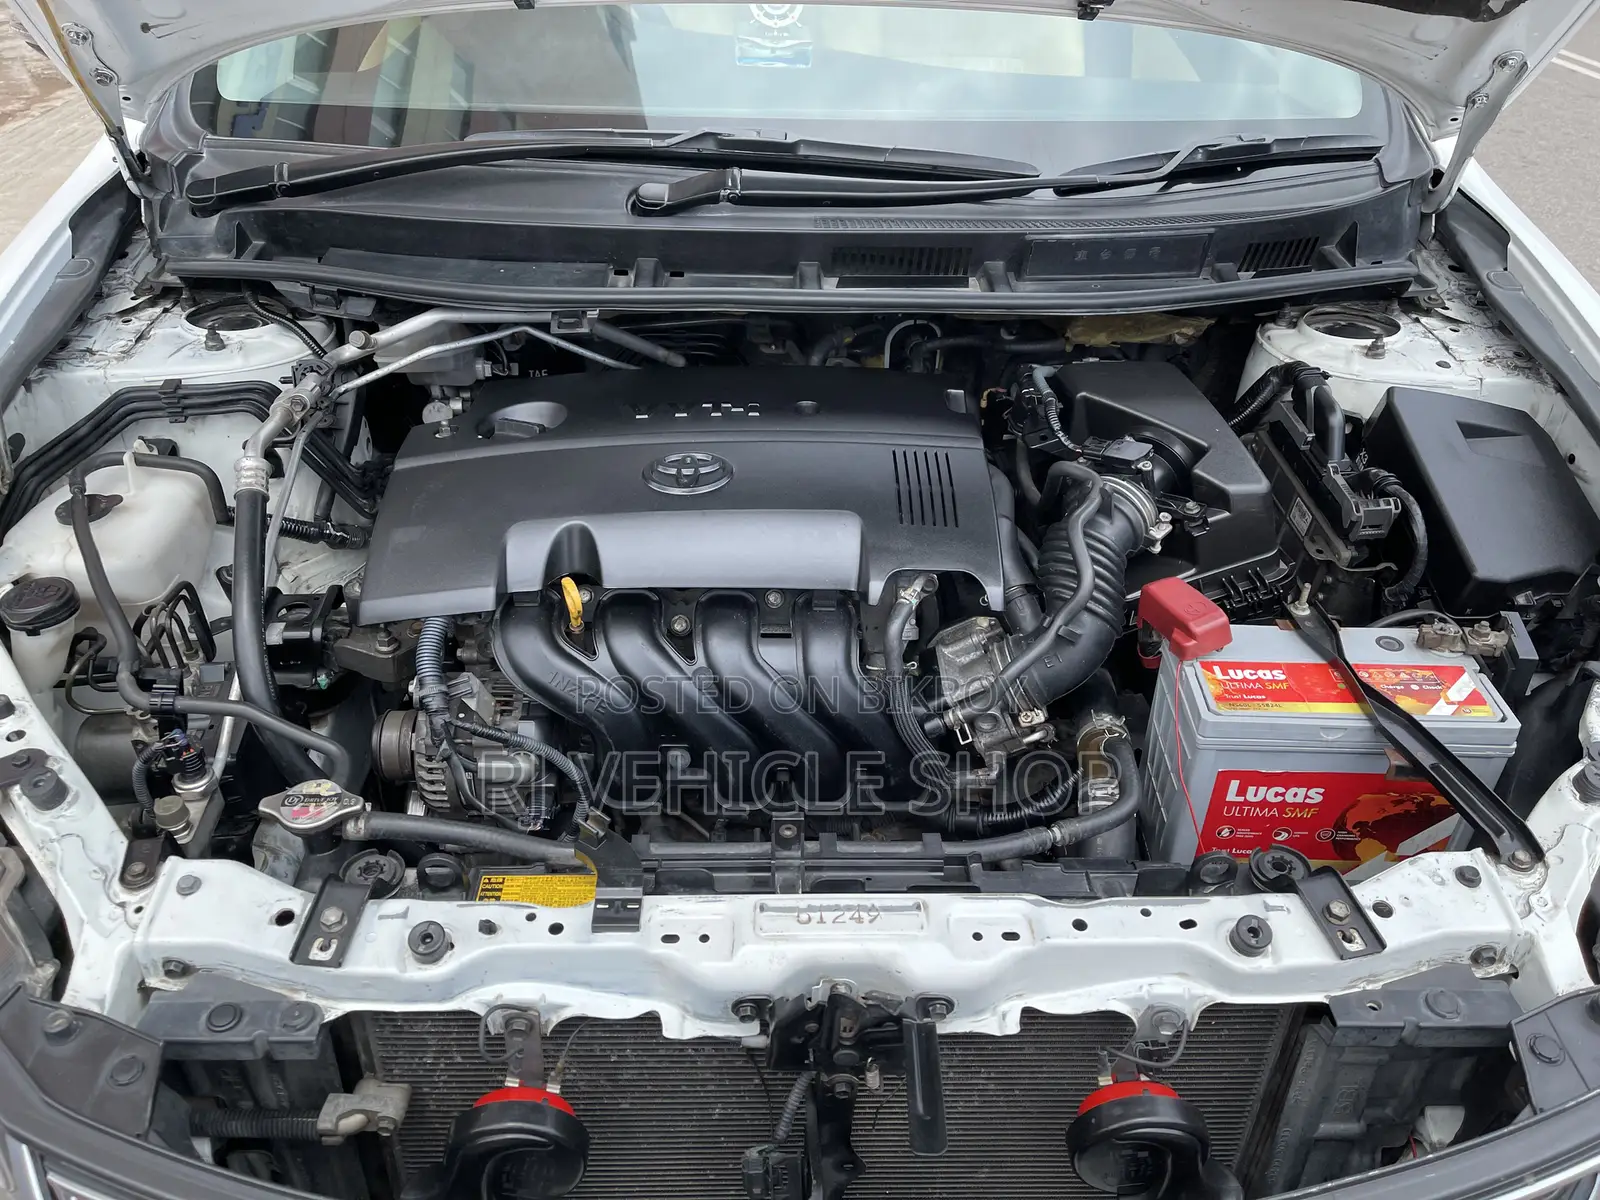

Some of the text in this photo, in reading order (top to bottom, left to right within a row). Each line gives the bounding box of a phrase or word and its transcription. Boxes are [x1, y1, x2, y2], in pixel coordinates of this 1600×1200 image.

[1212, 665, 1287, 681] Lucas
[1219, 681, 1290, 690] ULTIMA SMF
[1225, 780, 1326, 804] Lucas
[1223, 806, 1320, 818] ULTIMA SMF
[1231, 847, 1254, 855] Luca
